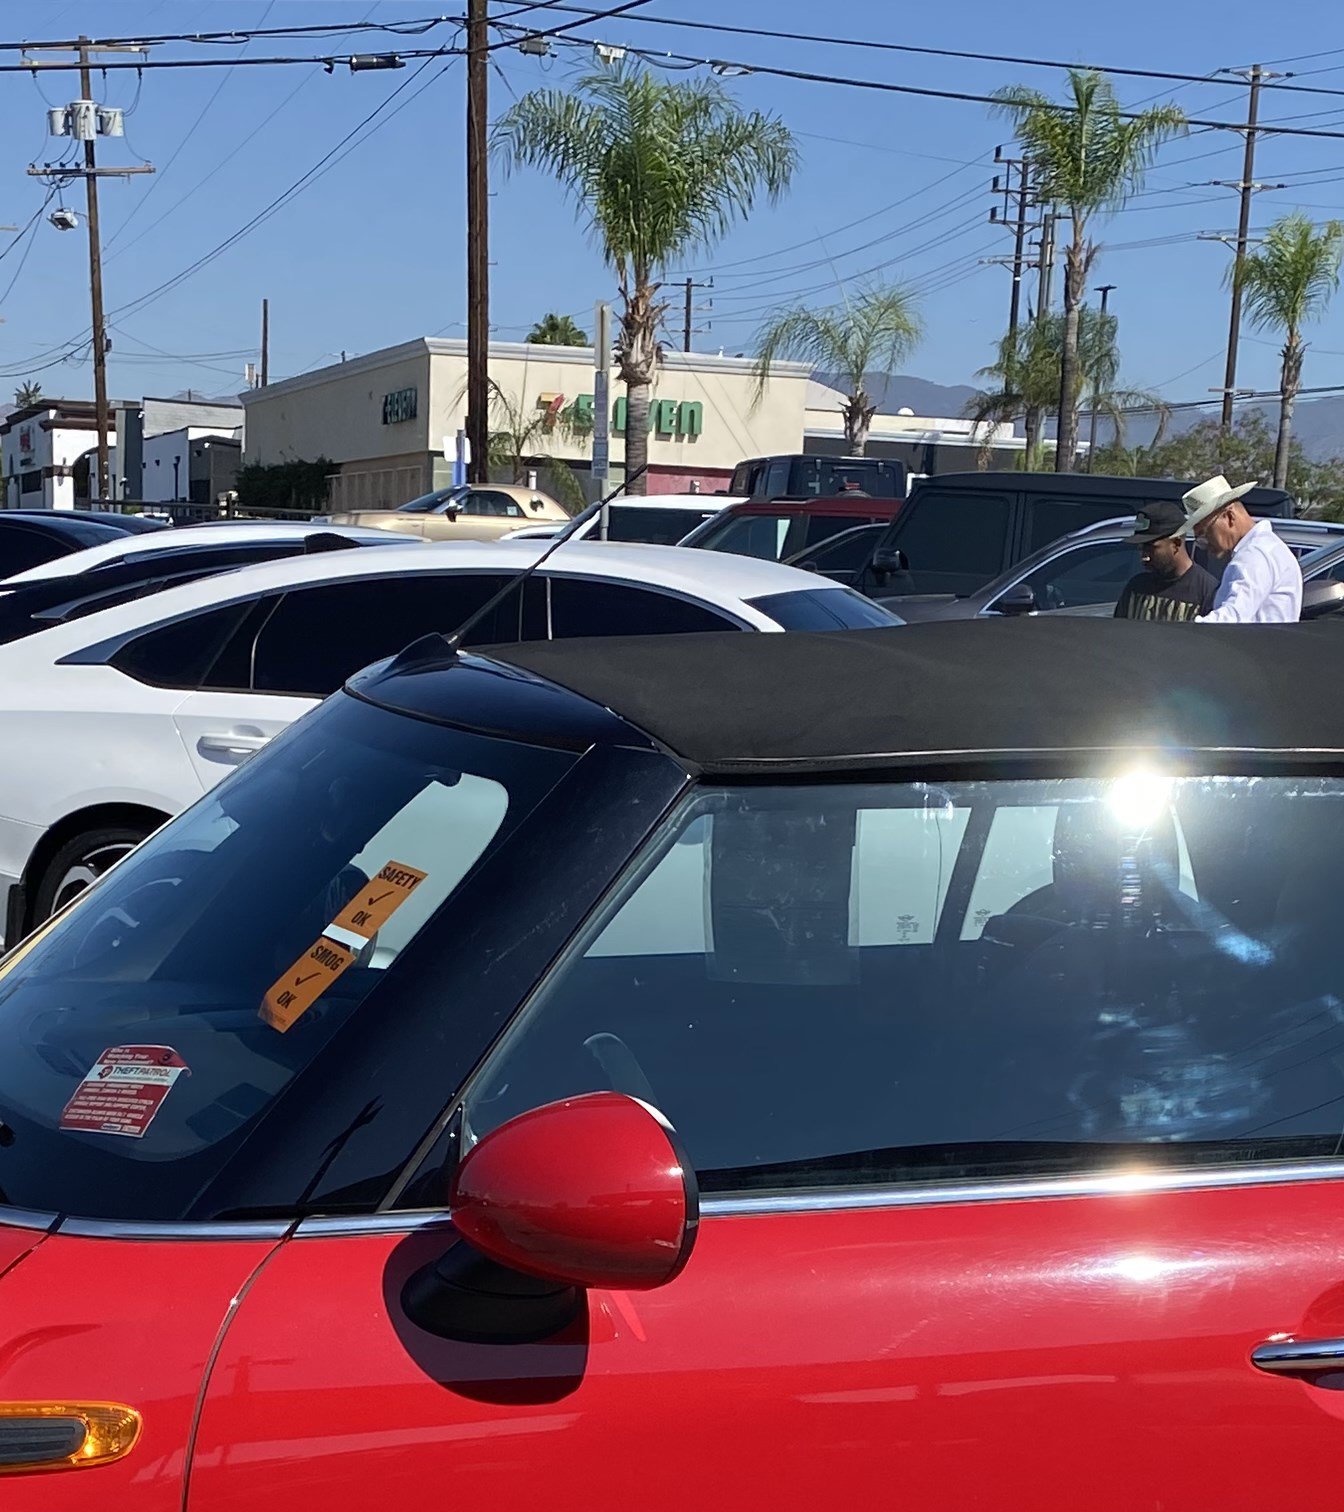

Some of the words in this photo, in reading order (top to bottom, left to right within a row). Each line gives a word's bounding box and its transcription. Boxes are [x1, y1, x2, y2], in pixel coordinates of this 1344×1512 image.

[378, 866, 422, 890] SAFETY
[351, 910, 372, 927] OK
[311, 945, 345, 972] SMOG
[276, 990, 297, 1009] OK
